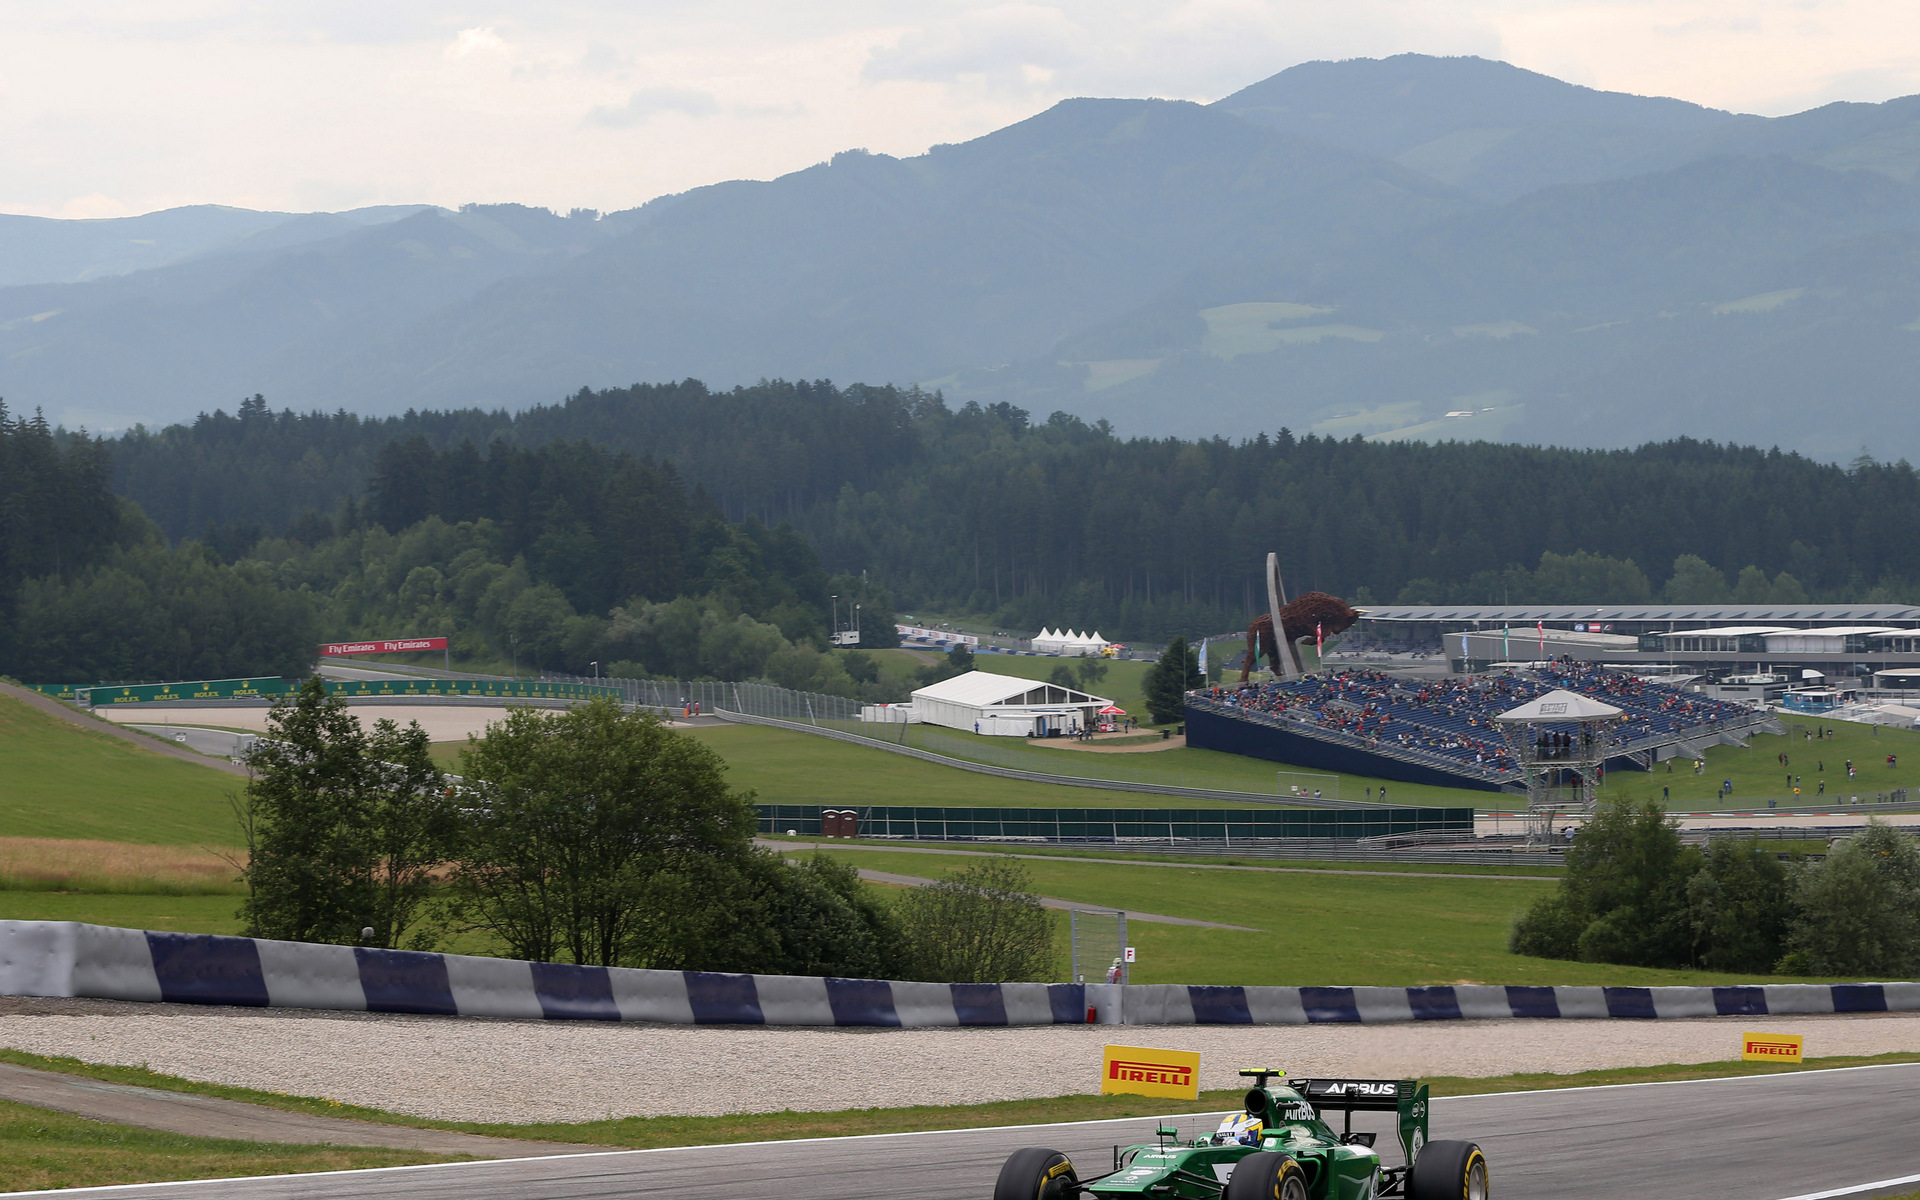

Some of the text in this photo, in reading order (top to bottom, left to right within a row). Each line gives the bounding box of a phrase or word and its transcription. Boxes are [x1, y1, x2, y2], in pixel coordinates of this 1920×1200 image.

[329, 644, 376, 654] Fly Emirates
[384, 641, 431, 651] Fly Emirates
[154, 693, 180, 701] ROLEX
[233, 688, 259, 696] ROLEX
[1127, 950, 1133, 959] F
[1746, 1041, 1798, 1056] PIRELLI
[1109, 1060, 1192, 1086] PIRELLI
